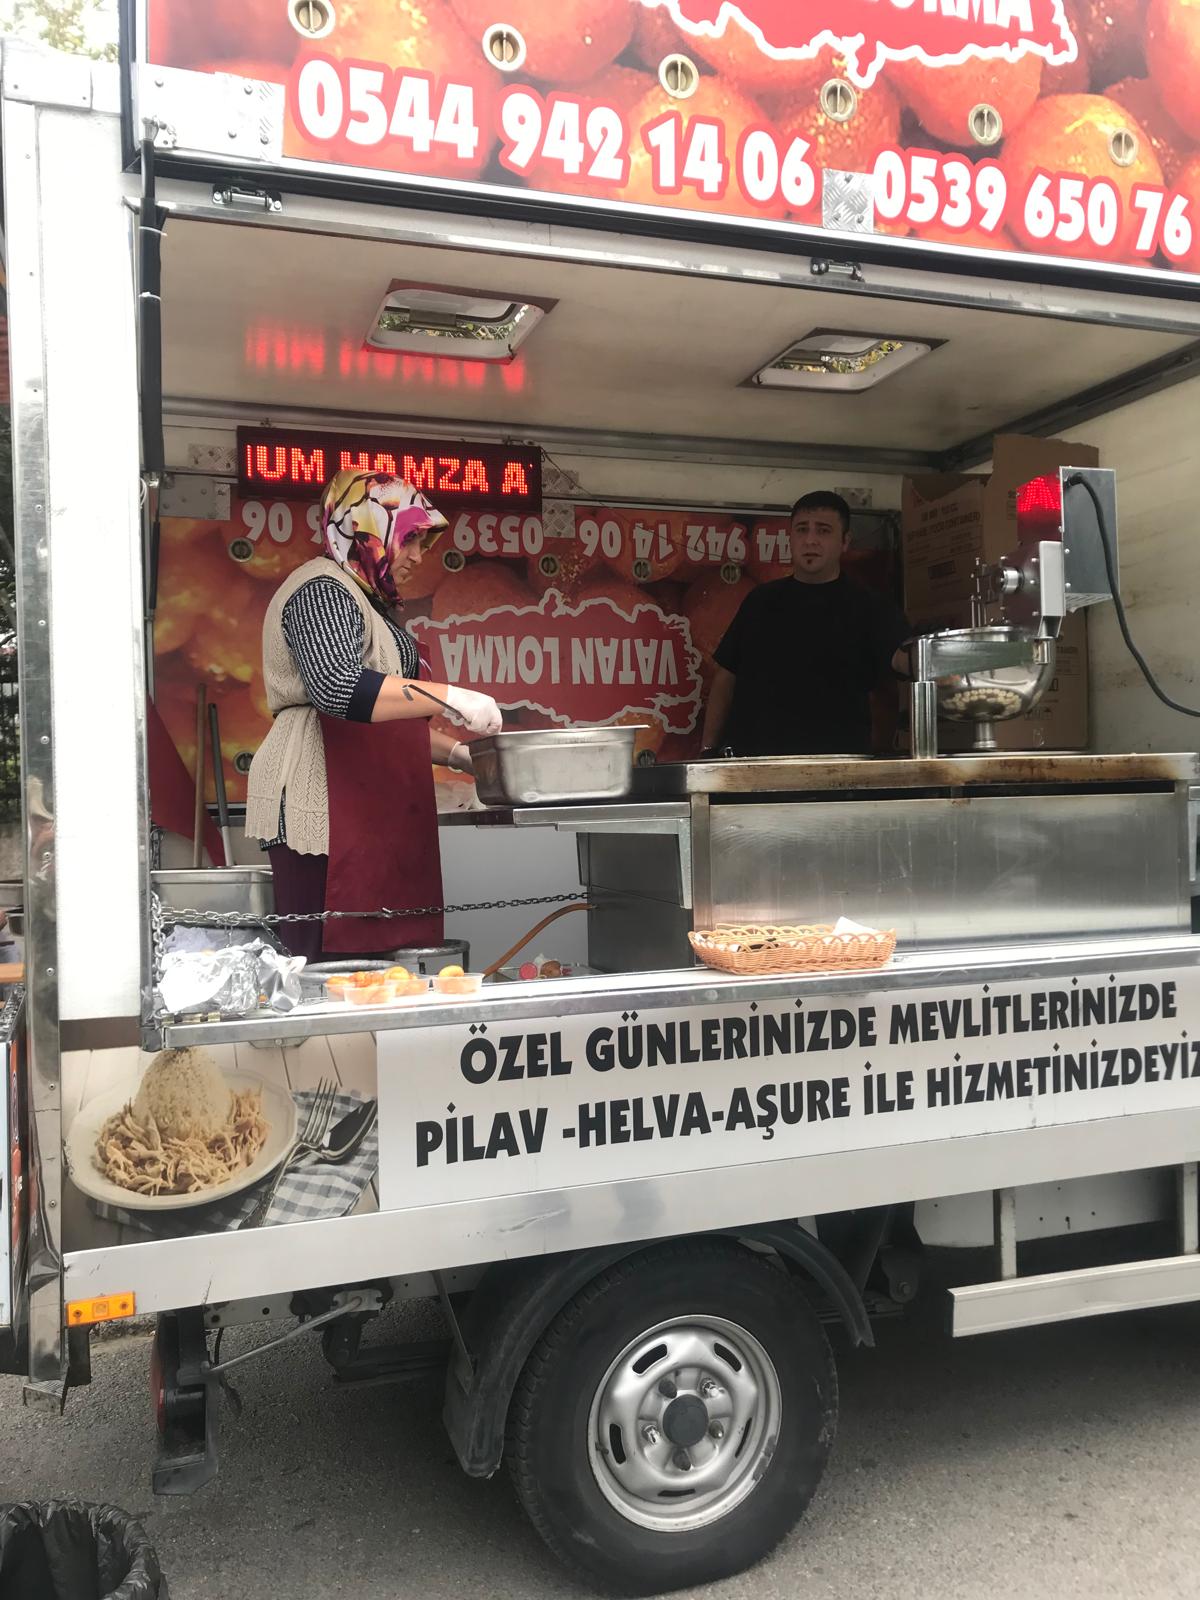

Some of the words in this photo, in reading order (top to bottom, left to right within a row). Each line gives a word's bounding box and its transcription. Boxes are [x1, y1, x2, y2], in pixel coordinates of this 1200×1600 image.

[299, 59, 479, 160] 0544
[501, 92, 624, 181] 942
[647, 119, 723, 193] 14
[742, 131, 816, 207] 06
[872, 151, 1007, 232] 0539
[1024, 175, 1118, 247] 650
[1134, 191, 1192, 256] 76
[340, 451, 489, 493] HAMZA
[453, 513, 544, 555] 0539
[579, 518, 622, 558] 06
[633, 522, 673, 560] 14
[686, 525, 746, 562] 942
[439, 633, 561, 684] LOKMA
[572, 637, 679, 685] VATAN
[460, 1023, 573, 1085] ÖZEL
[585, 998, 878, 1072] GÜNLERİNİZDE
[889, 973, 1178, 1045] MEVLİTLERİNİZDE
[416, 1101, 548, 1168] PİLAV
[864, 1060, 915, 1116] İLE
[927, 1030, 1200, 1109] HİZMETİNİZDEYİZ
